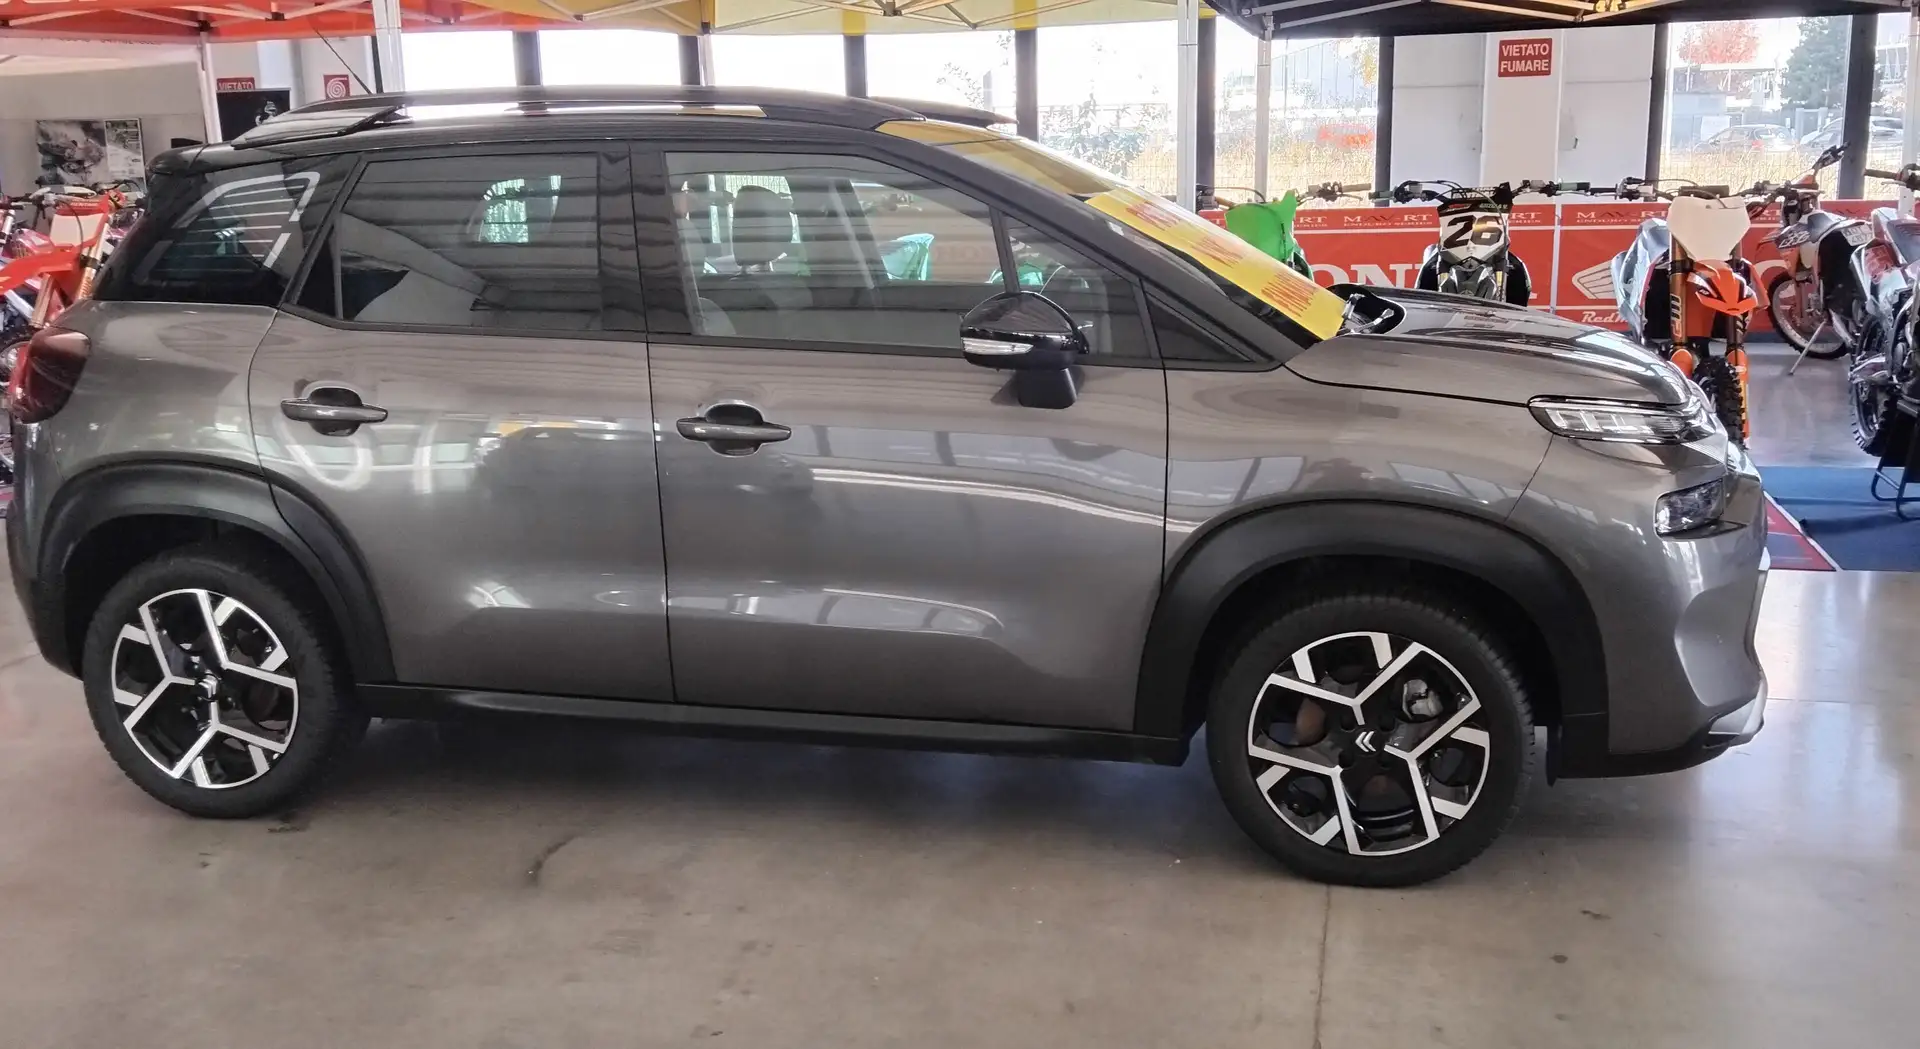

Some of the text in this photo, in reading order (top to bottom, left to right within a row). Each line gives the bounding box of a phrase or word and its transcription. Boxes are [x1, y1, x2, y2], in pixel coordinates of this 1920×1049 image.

[1502, 43, 1550, 57] VIETATO
[1500, 59, 1549, 73] FUMARE
[218, 81, 254, 91] VIETATO
[1442, 214, 1503, 250] 26
